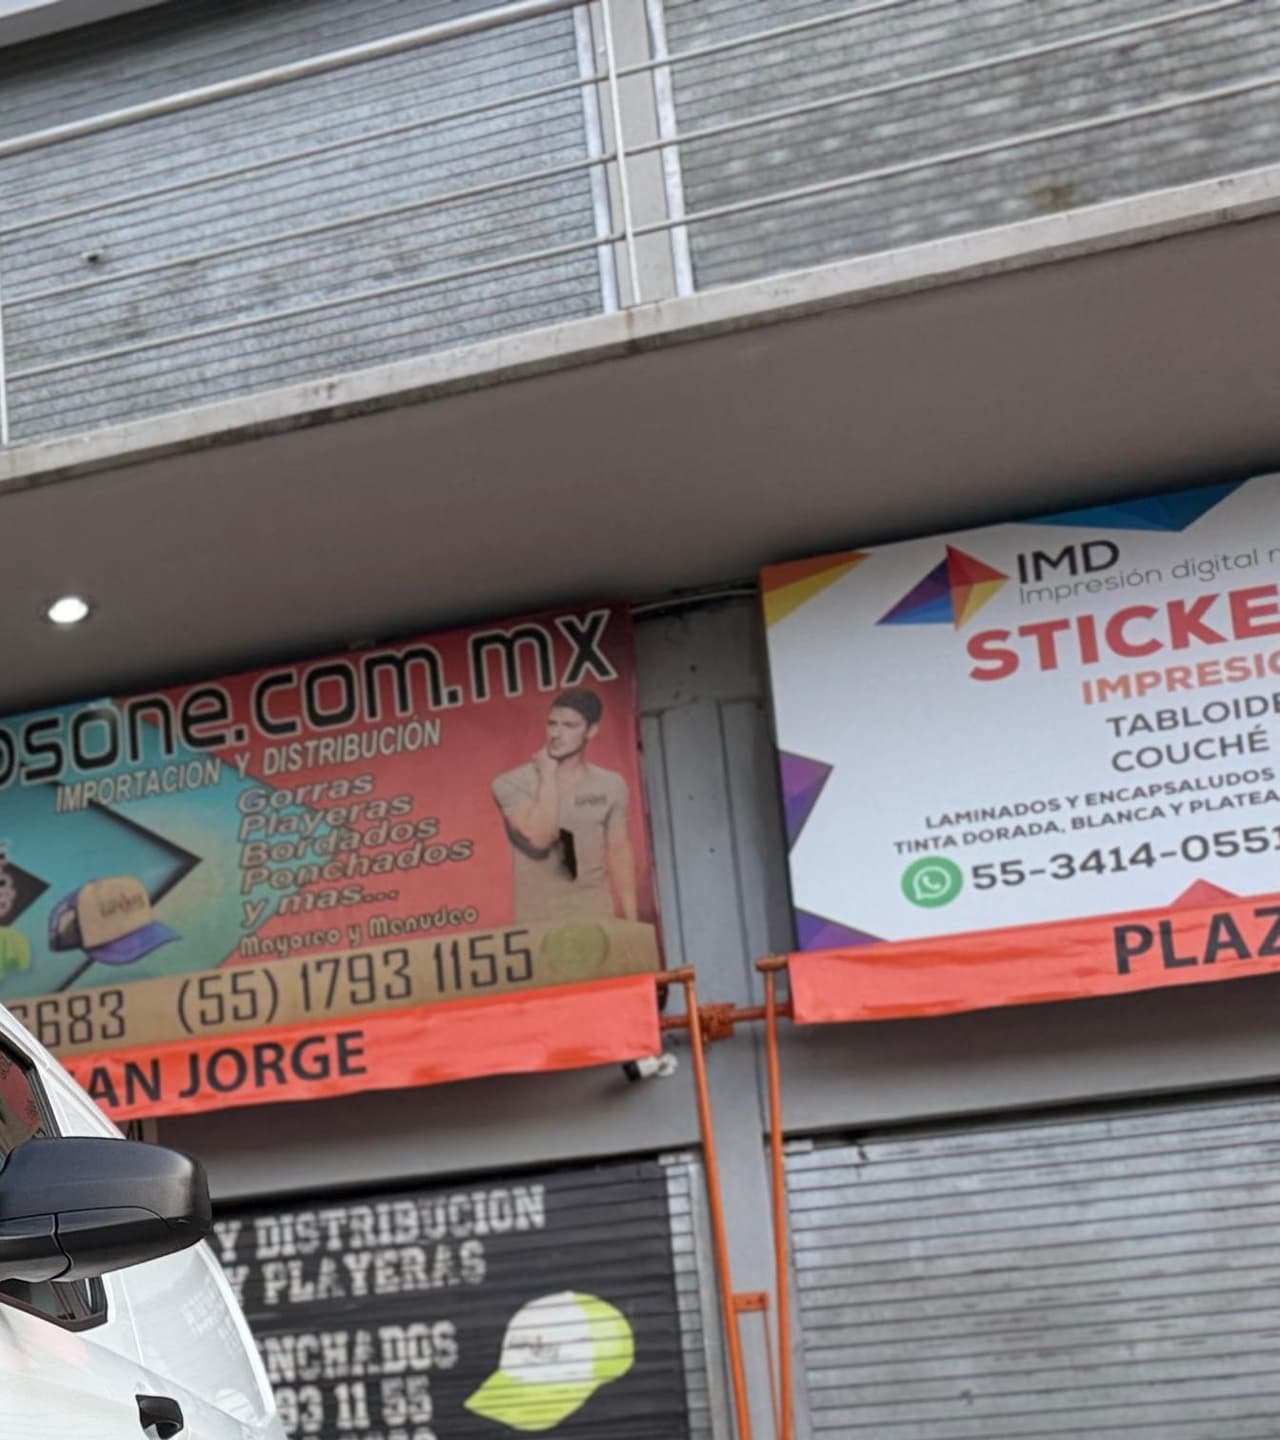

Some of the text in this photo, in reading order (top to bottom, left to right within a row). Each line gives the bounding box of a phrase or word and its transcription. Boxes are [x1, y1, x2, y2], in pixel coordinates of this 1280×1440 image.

[1016, 539, 1120, 583] IMD
[1020, 548, 1258, 606] Impresión digital
[236, 753, 249, 777] Y
[1112, 726, 1270, 773] COUCHÉ
[239, 773, 373, 814] Gorras
[239, 794, 414, 841] Playeras
[925, 768, 1274, 829] LAMINADOS Y ENCAPSALUDOS
[240, 816, 439, 869] Bordados
[893, 837, 958, 855] TINTA
[1071, 805, 1165, 830] BLANCA
[1170, 803, 1184, 817] Y
[240, 839, 474, 894] Ponchados
[240, 928, 340, 958] Mayoreo
[369, 906, 478, 938] Menudeo
[242, 898, 266, 927] y
[177, 971, 278, 1034] (55)
[301, 949, 412, 1010] 1793
[434, 930, 533, 991] 1155
[70, 1030, 367, 1109] AN JORGE
[255, 1184, 546, 1258] DISTRIBUCION
[263, 1241, 487, 1304] PLAYERAS
[382, 1376, 433, 1426] 55
